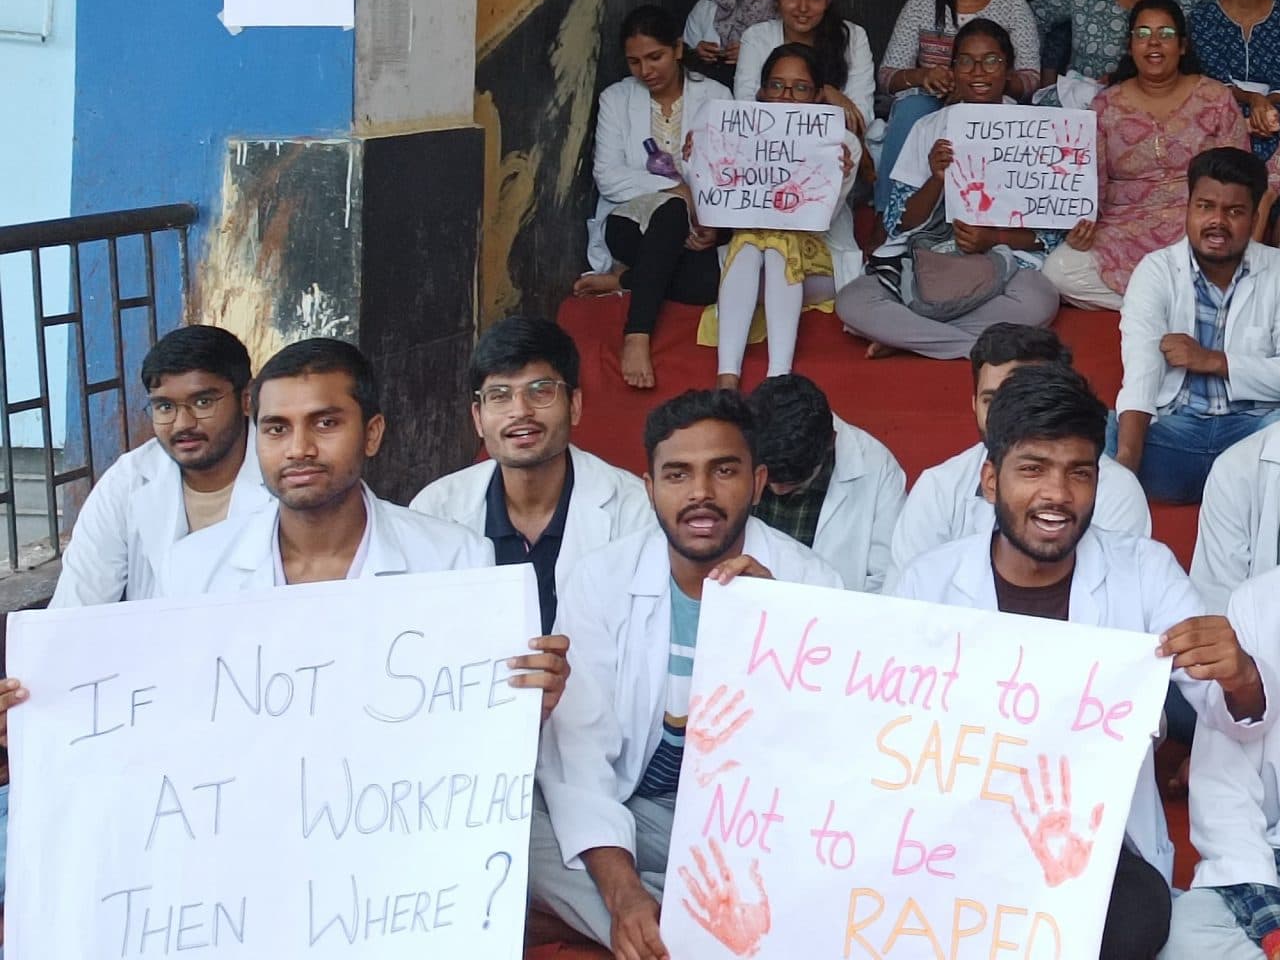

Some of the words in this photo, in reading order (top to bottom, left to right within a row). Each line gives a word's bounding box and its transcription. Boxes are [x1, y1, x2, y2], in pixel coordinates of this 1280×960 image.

[721, 108, 775, 138] HAND
[786, 110, 835, 138] THAT
[965, 118, 1050, 140] JUSTICE
[755, 139, 806, 163] HEAL
[991, 144, 1065, 167] DELAYED
[1069, 147, 1092, 166] IS
[716, 166, 791, 188] SHOULD
[1004, 170, 1085, 192] JUSTICE
[698, 187, 736, 210] NOT
[733, 189, 800, 211] BLEED
[1021, 195, 1094, 217] DENIED
[69, 673, 156, 746] IF
[211, 645, 335, 722] NOT
[364, 630, 518, 723] SAFE
[747, 610, 832, 693] We
[845, 632, 962, 713] want
[996, 645, 1040, 725] to
[1071, 661, 1134, 741] be
[870, 715, 1029, 803] SAFE
[145, 774, 236, 851] AT
[300, 756, 532, 840] WORKPLACE
[701, 776, 784, 853] Not
[810, 799, 856, 870] to
[891, 808, 957, 879] be
[101, 884, 246, 958] THEN
[308, 874, 459, 947] WHERE
